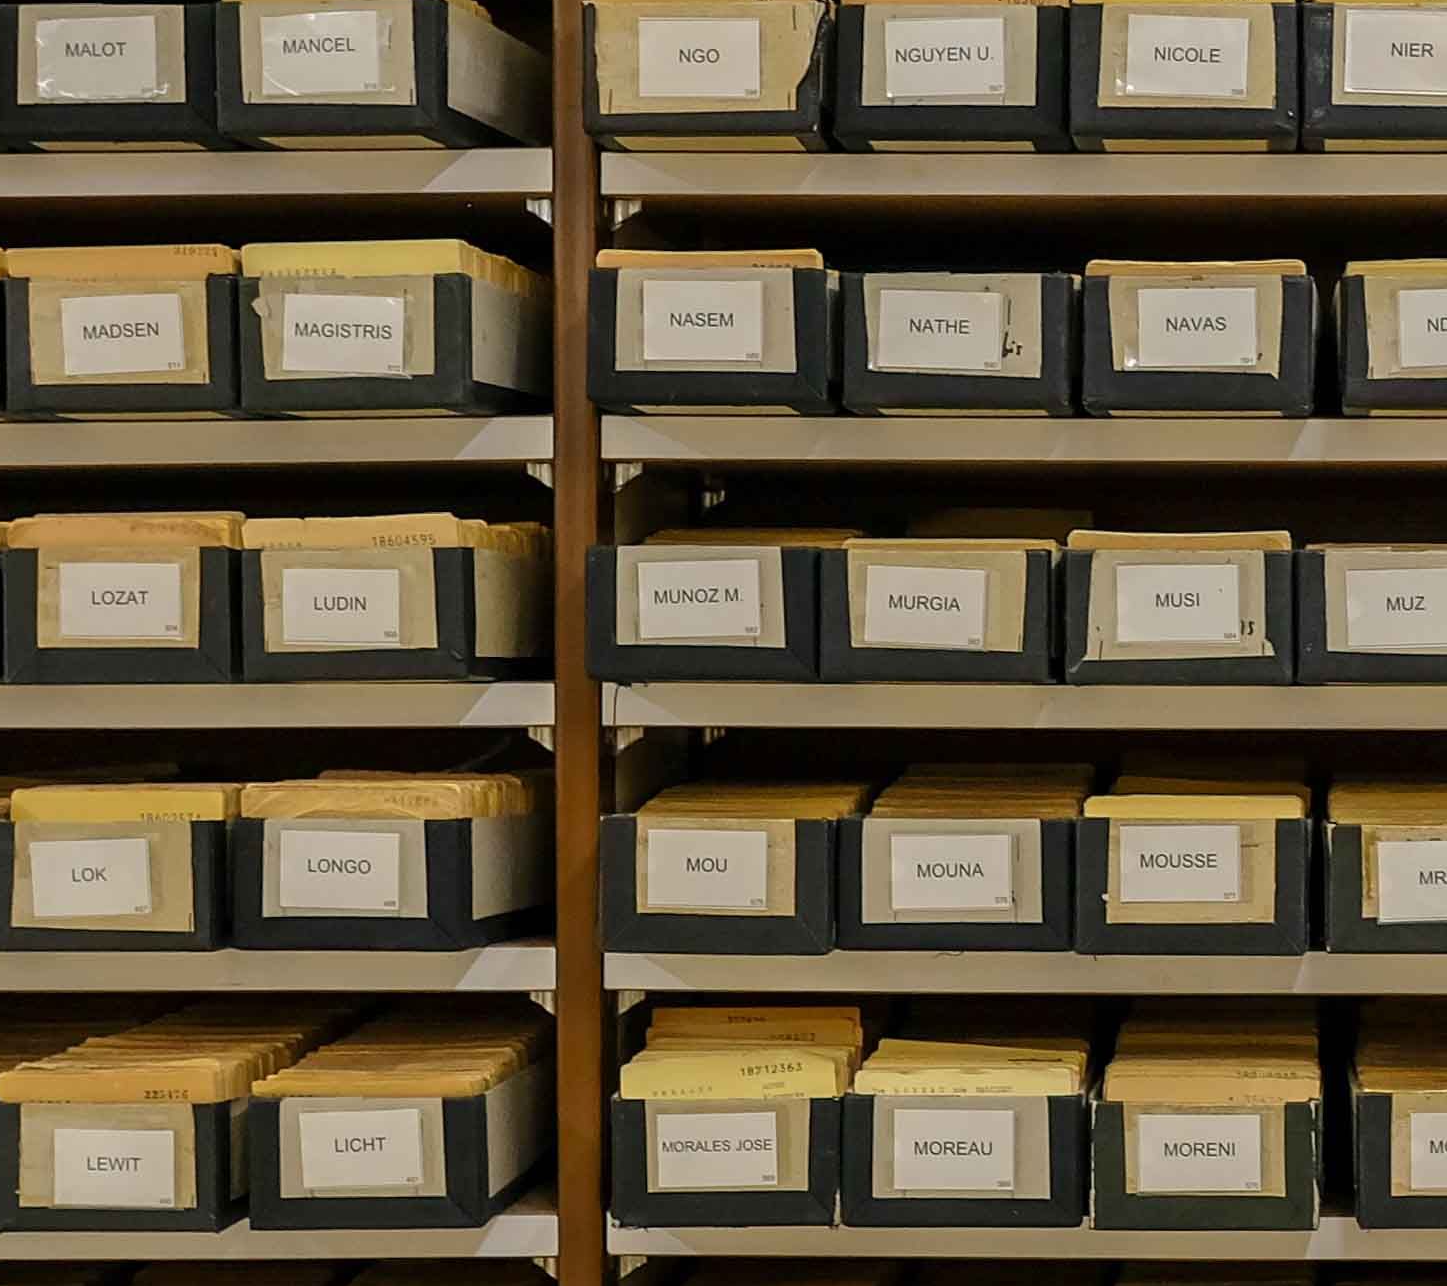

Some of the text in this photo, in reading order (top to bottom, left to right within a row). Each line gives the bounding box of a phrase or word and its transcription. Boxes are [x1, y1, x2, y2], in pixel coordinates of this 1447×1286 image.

[64, 41, 127, 58] MALOT
[282, 37, 356, 54] MANCEL
[1391, 42, 1434, 58] NIER
[678, 48, 721, 64] NGO
[895, 46, 972, 63] NGUYEN
[1154, 46, 1221, 64] NICOLE
[82, 322, 160, 340] MADSEN
[294, 322, 393, 340] MAGISTRIS
[909, 318, 970, 335] NATHE
[1165, 316, 1227, 332] NAVAS
[91, 590, 149, 606] LOZAT
[313, 596, 367, 612] LUDIN
[888, 594, 961, 612] MURGIA
[1155, 592, 1200, 609] MUSI
[307, 858, 372, 875] LONGO
[686, 857, 728, 873] MOU
[1139, 853, 1218, 869] MOUSSE
[334, 1136, 387, 1153] LICHT
[661, 1137, 773, 1153] MORALES JOSE
[914, 1140, 993, 1156] MOREAU
[1163, 1142, 1236, 1158] MORENI
[86, 1156, 142, 1172] LEWIT
